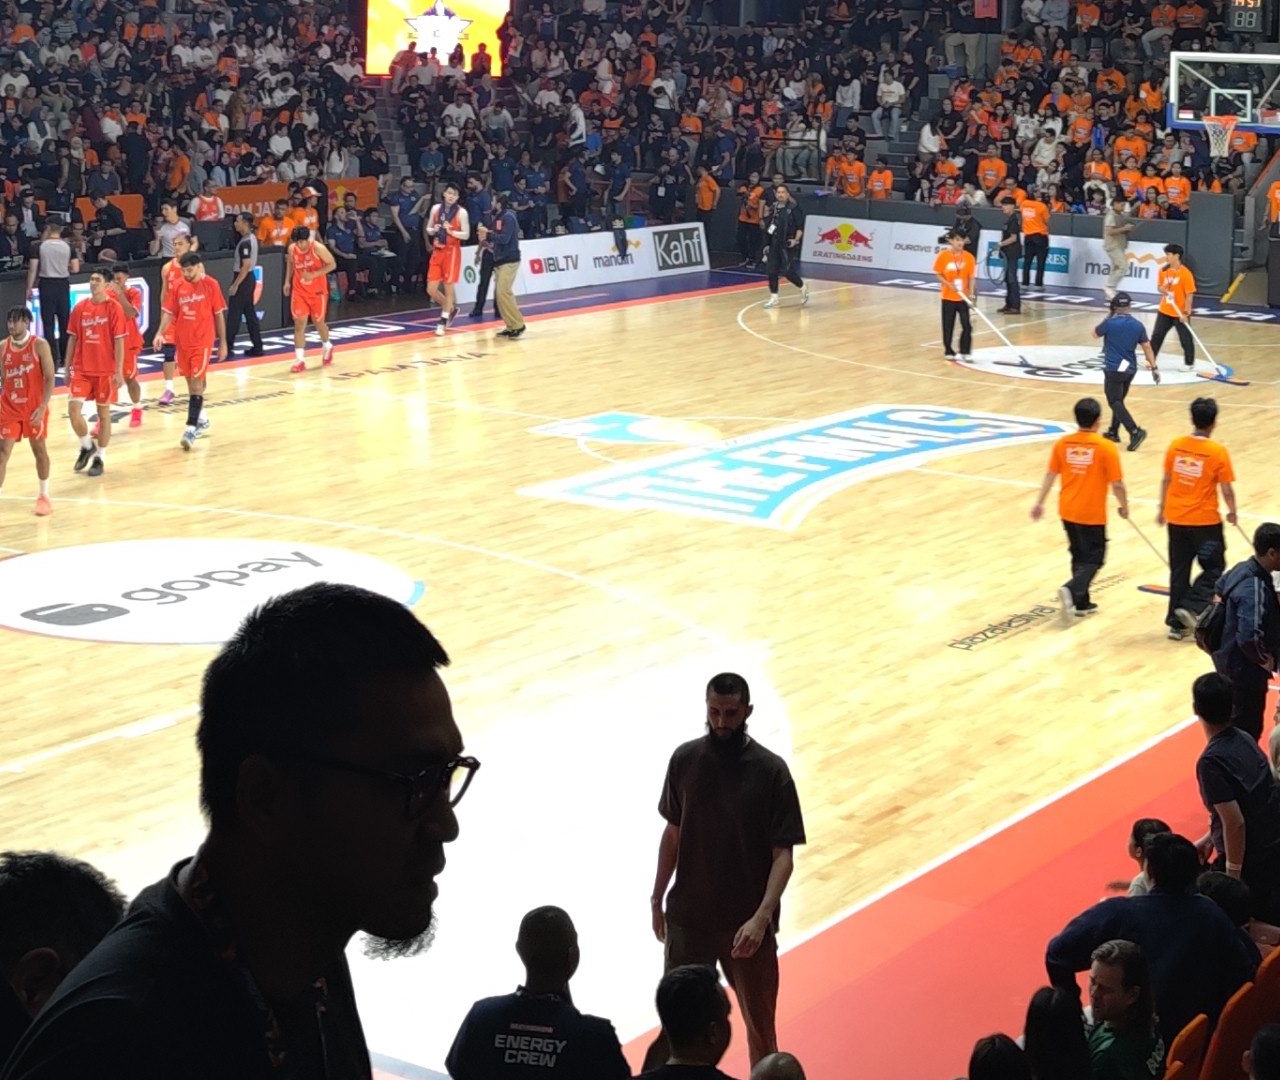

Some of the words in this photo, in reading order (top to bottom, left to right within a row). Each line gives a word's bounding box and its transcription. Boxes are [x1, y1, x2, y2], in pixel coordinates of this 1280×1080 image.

[654, 230, 702, 268] Kahf
[14, 378, 24, 389] 21
[121, 550, 323, 605] gopay
[494, 1033, 567, 1054] ENERGY
[504, 1049, 557, 1068] CREW
